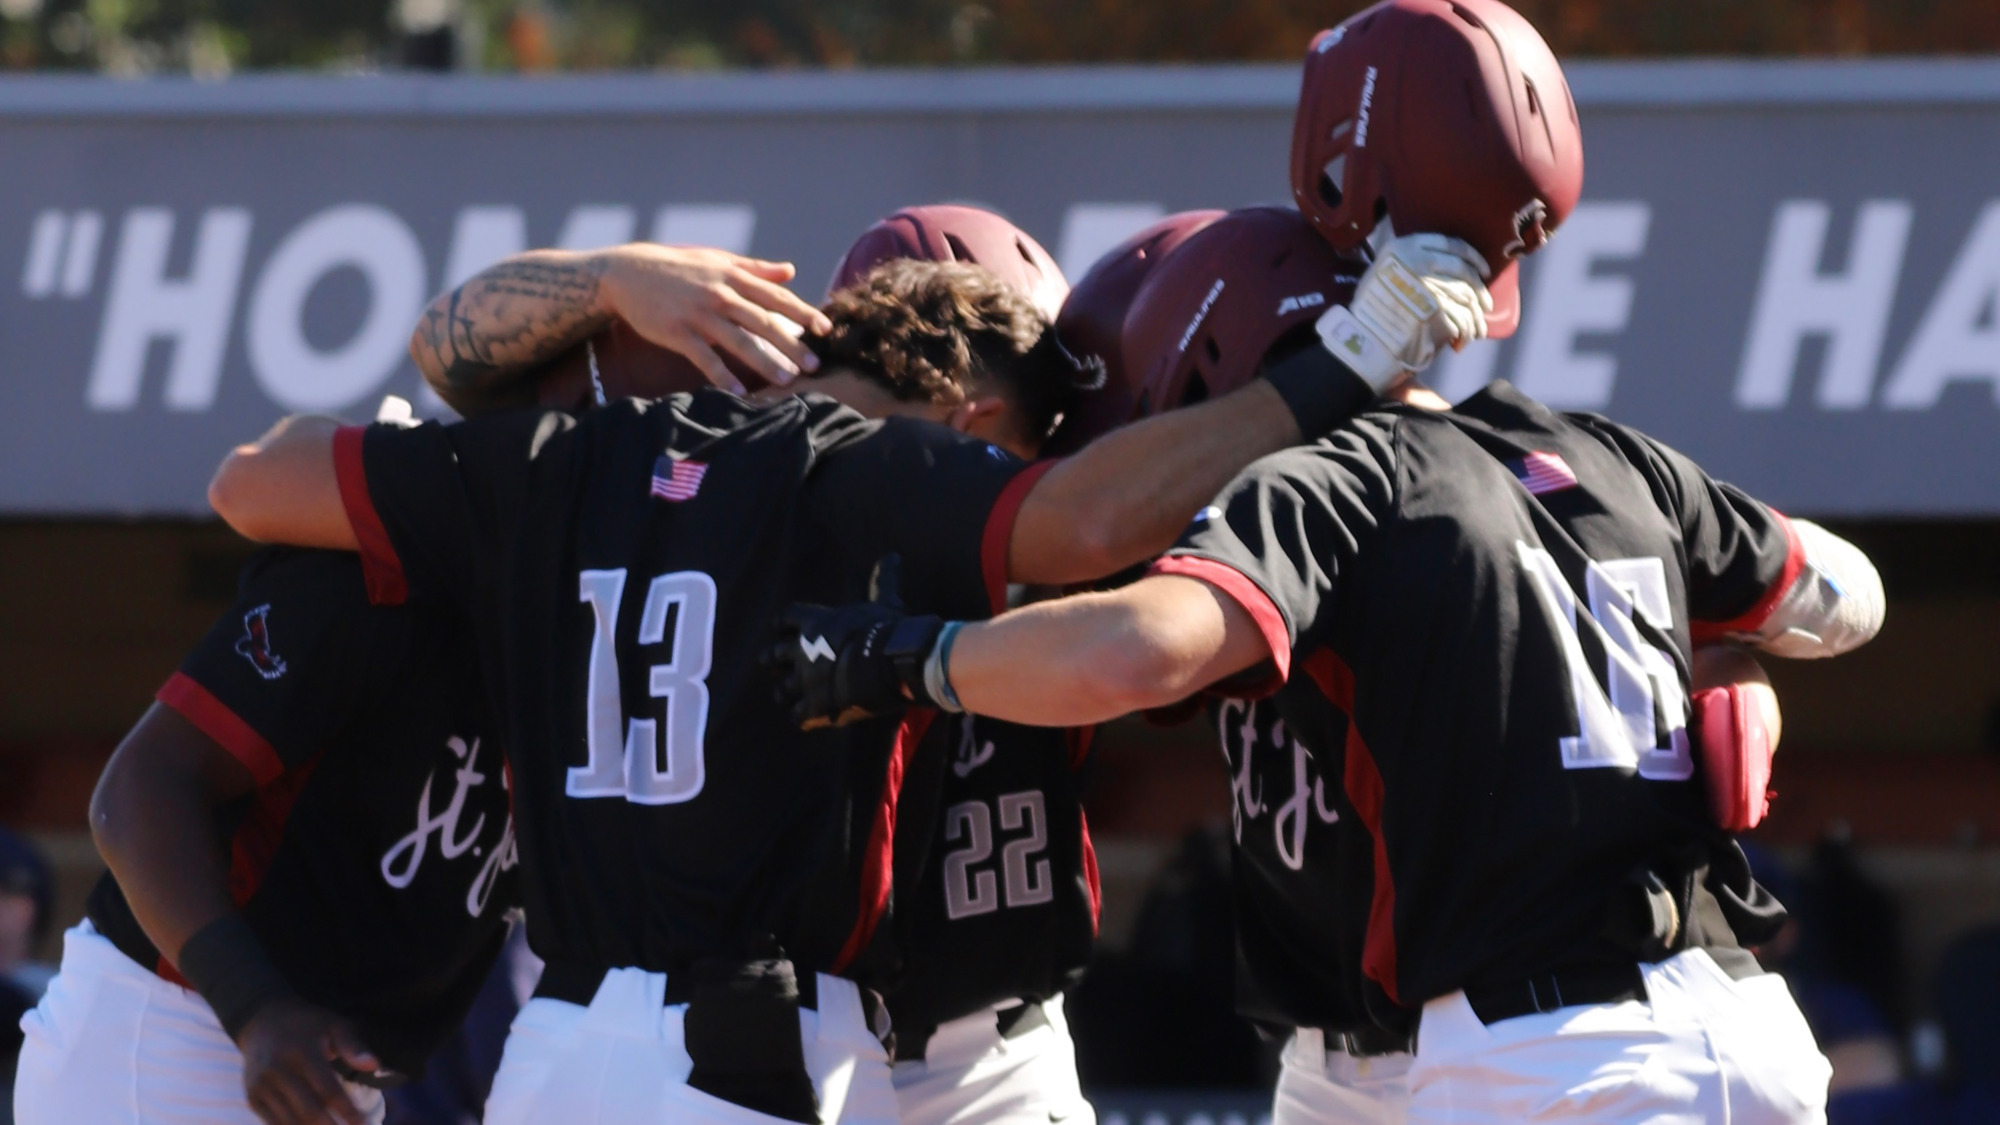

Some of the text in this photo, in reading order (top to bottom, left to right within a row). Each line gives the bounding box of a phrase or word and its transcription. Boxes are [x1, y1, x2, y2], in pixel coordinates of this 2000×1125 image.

[24, 203, 757, 413] "HO
[565, 568, 718, 806] 13
[1515, 539, 1694, 781] 16
[943, 789, 1054, 920] 22
